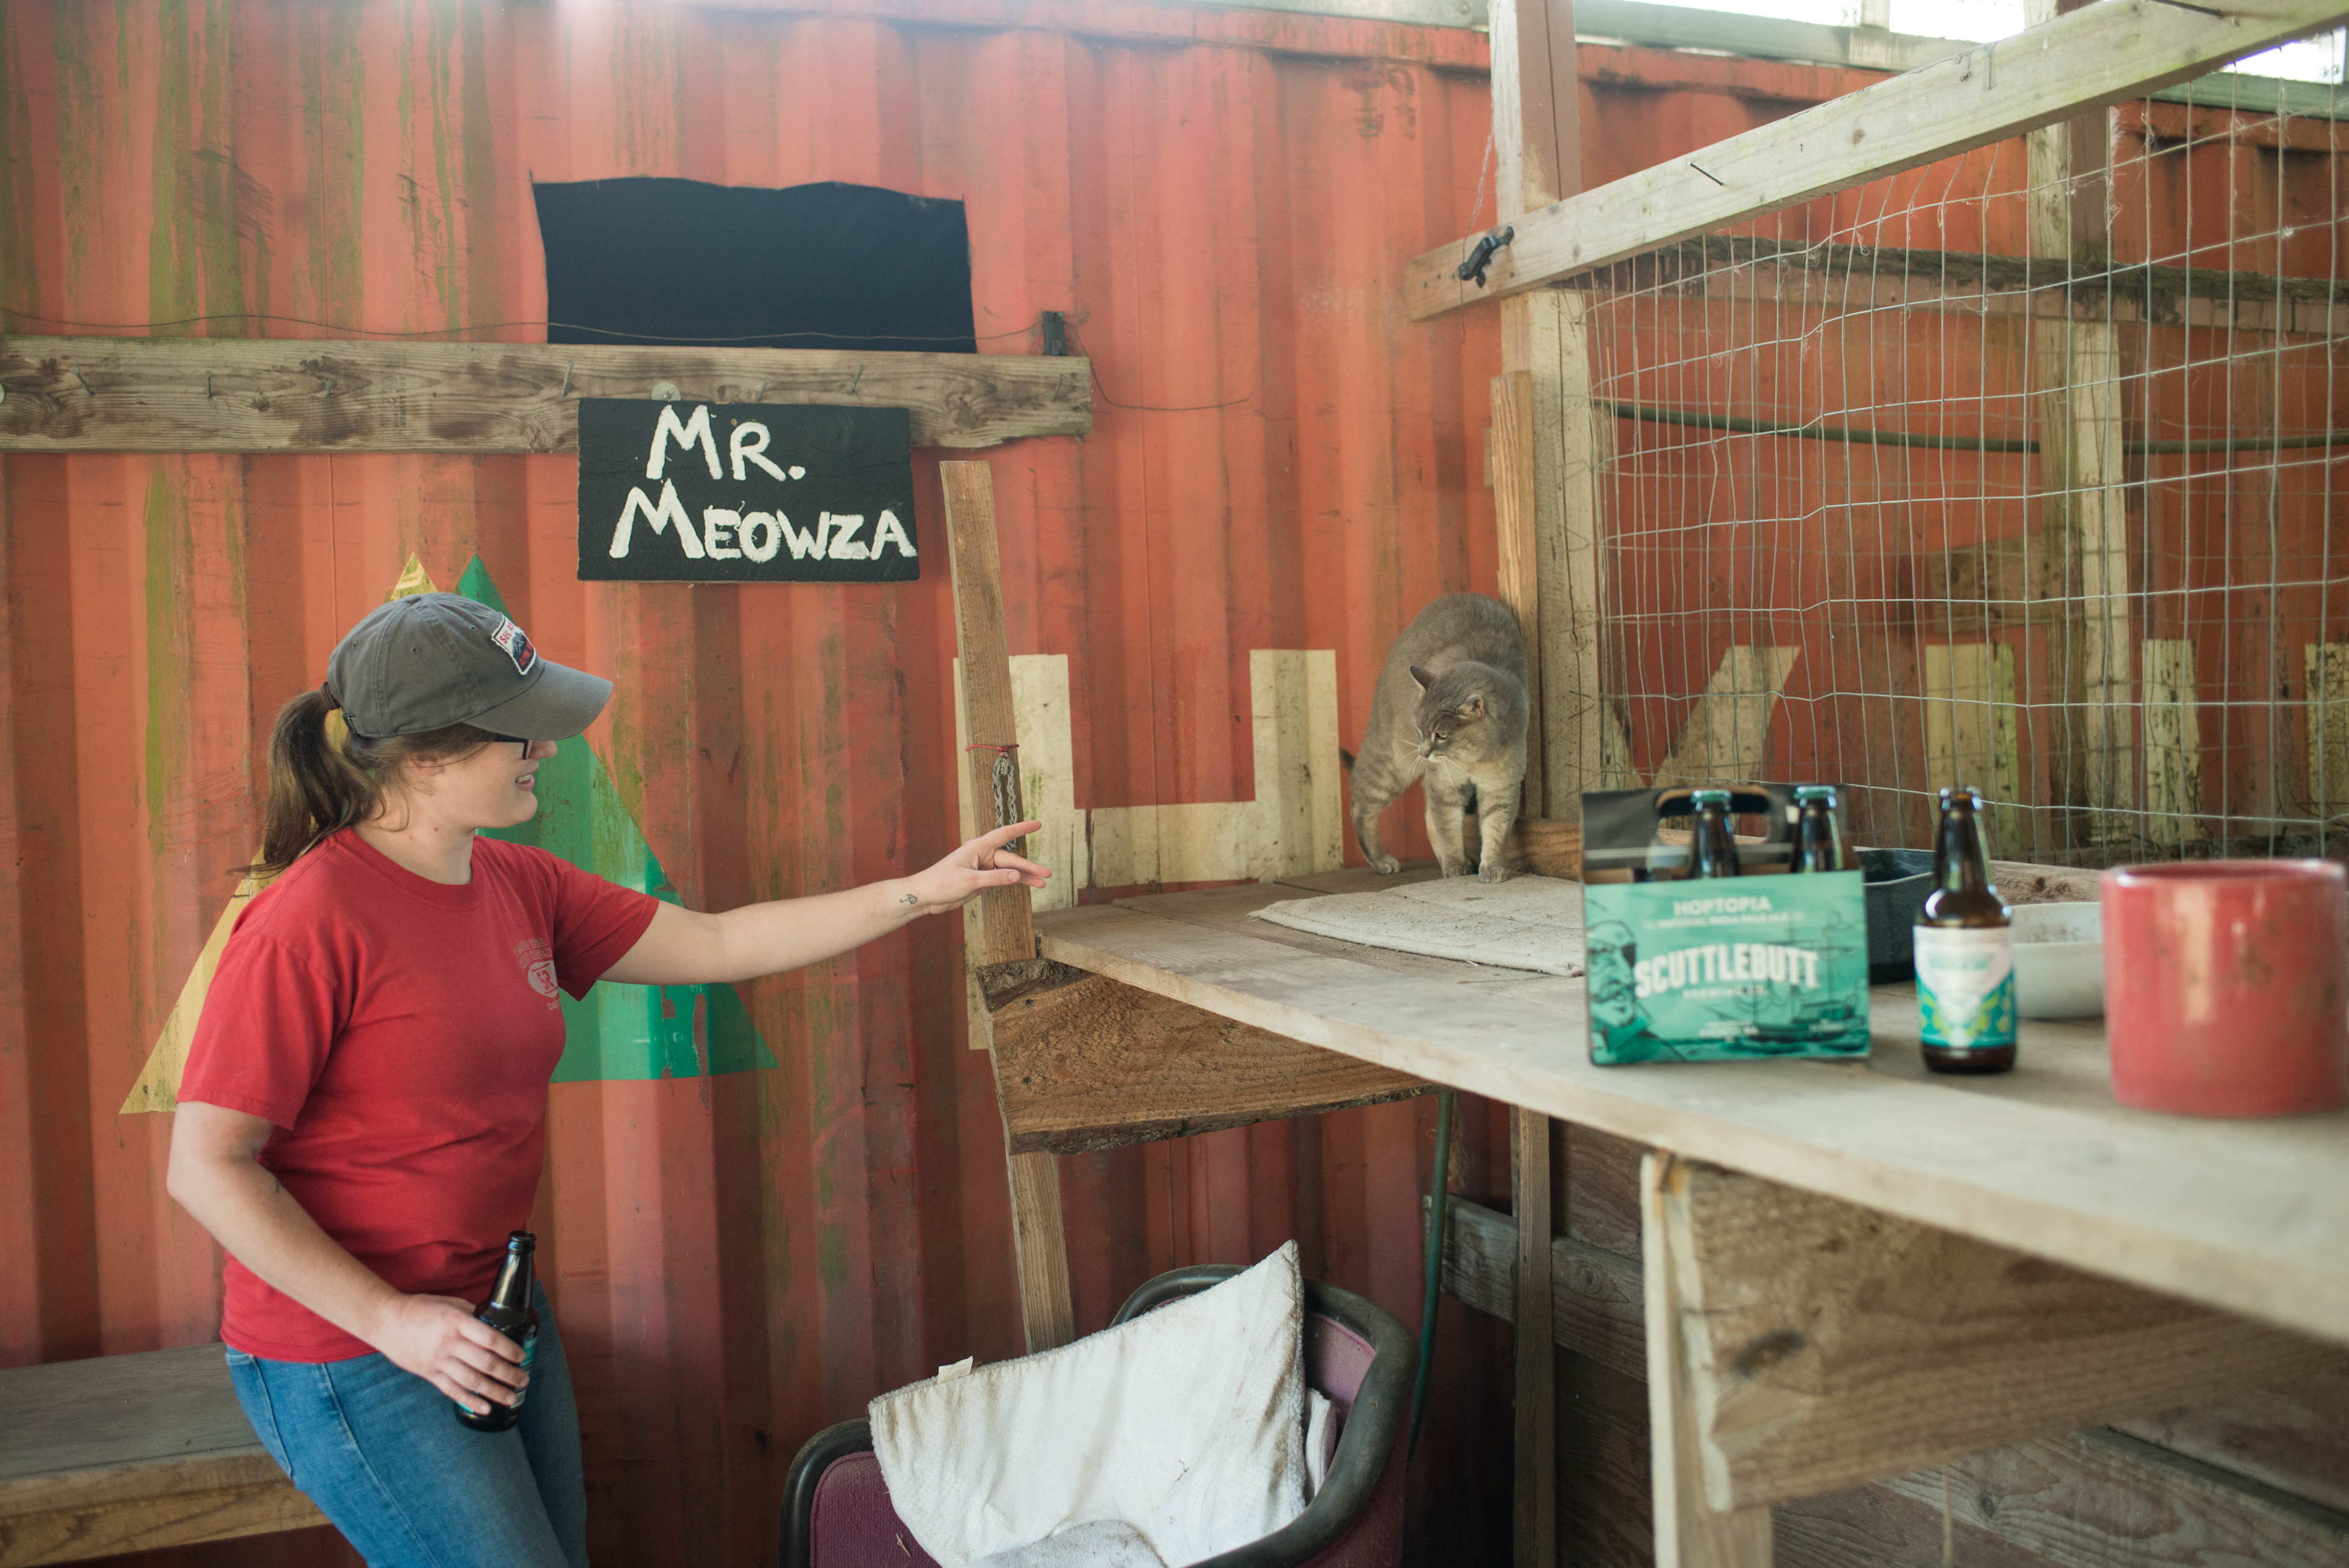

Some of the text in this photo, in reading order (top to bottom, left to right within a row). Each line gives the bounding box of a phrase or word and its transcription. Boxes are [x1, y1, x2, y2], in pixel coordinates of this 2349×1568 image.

[646, 404, 806, 481] MR.
[609, 478, 917, 563] MEOWZA
[1673, 896, 1773, 916] HOPTOPIA
[1634, 943, 1819, 998] SCUTTLEBUTT
